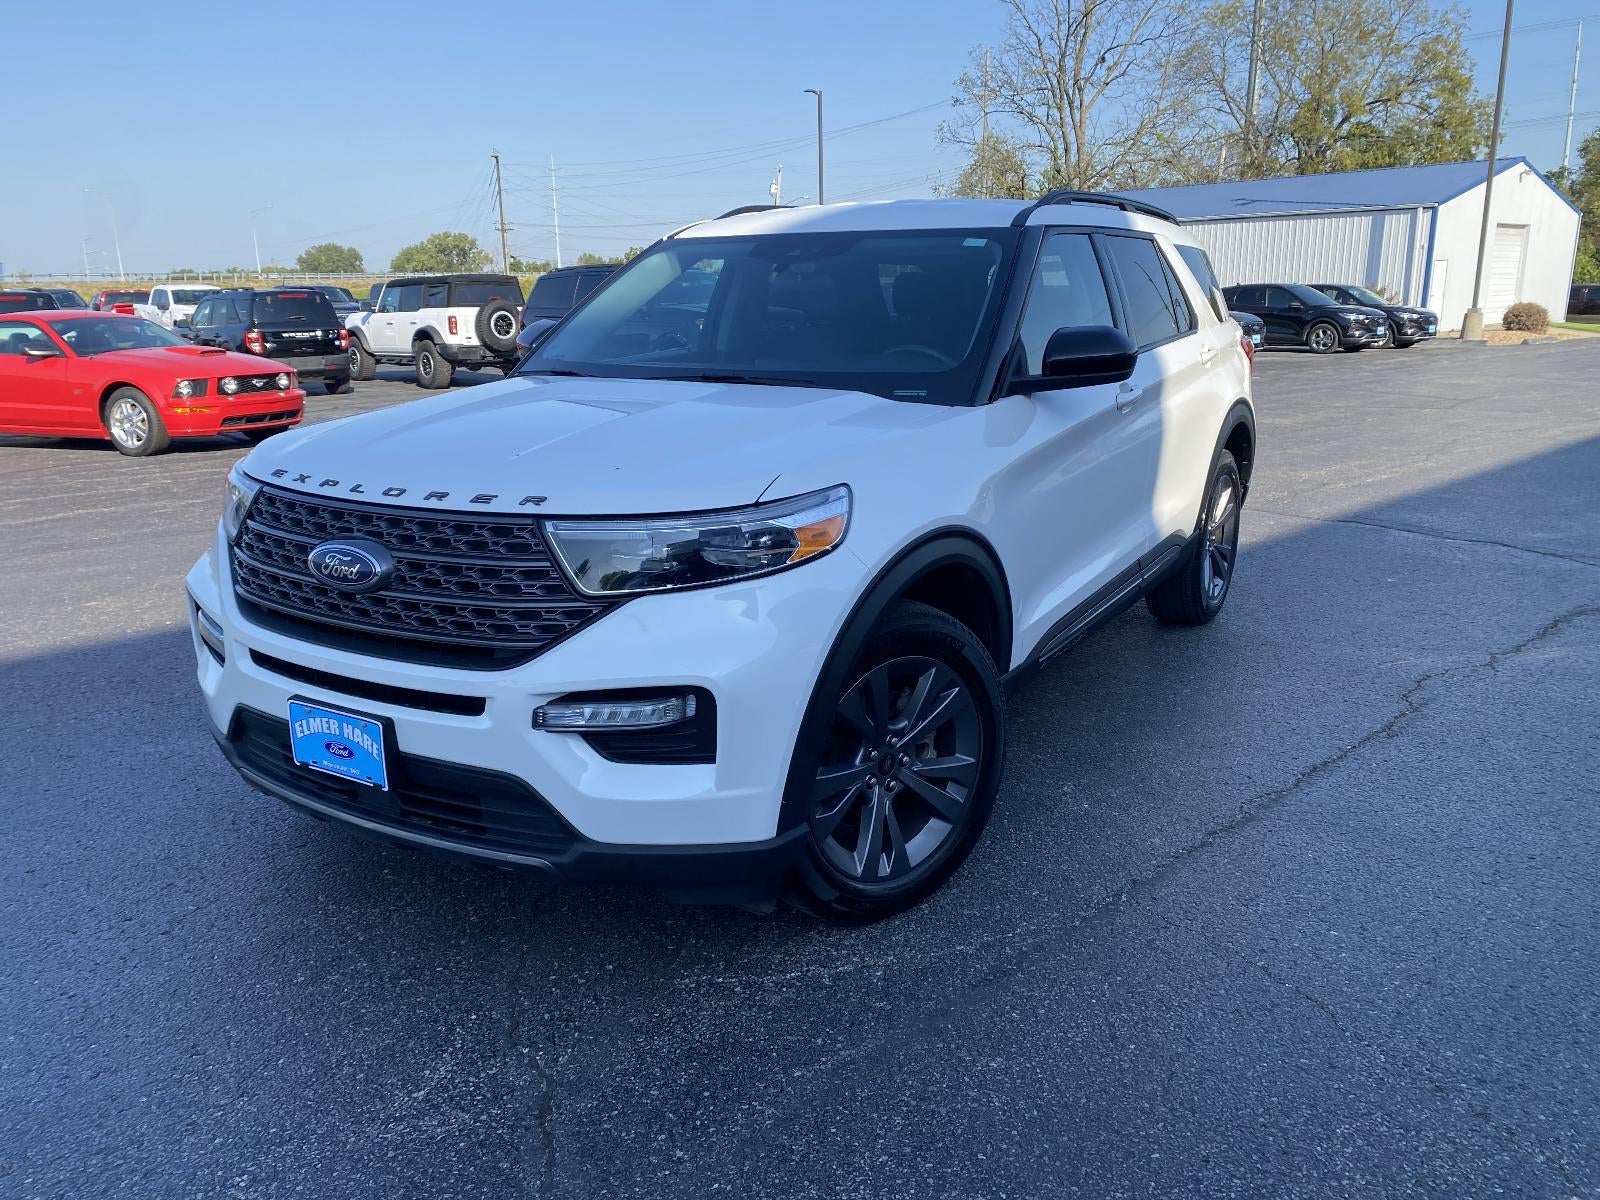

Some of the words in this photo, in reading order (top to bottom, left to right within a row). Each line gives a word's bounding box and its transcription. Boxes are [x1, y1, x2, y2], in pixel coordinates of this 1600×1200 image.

[270, 468, 548, 506] EXPLORER
[320, 553, 361, 580] Ford
[295, 718, 340, 739] ELMER
[343, 722, 380, 760] HARE
[329, 743, 349, 757] Ford
